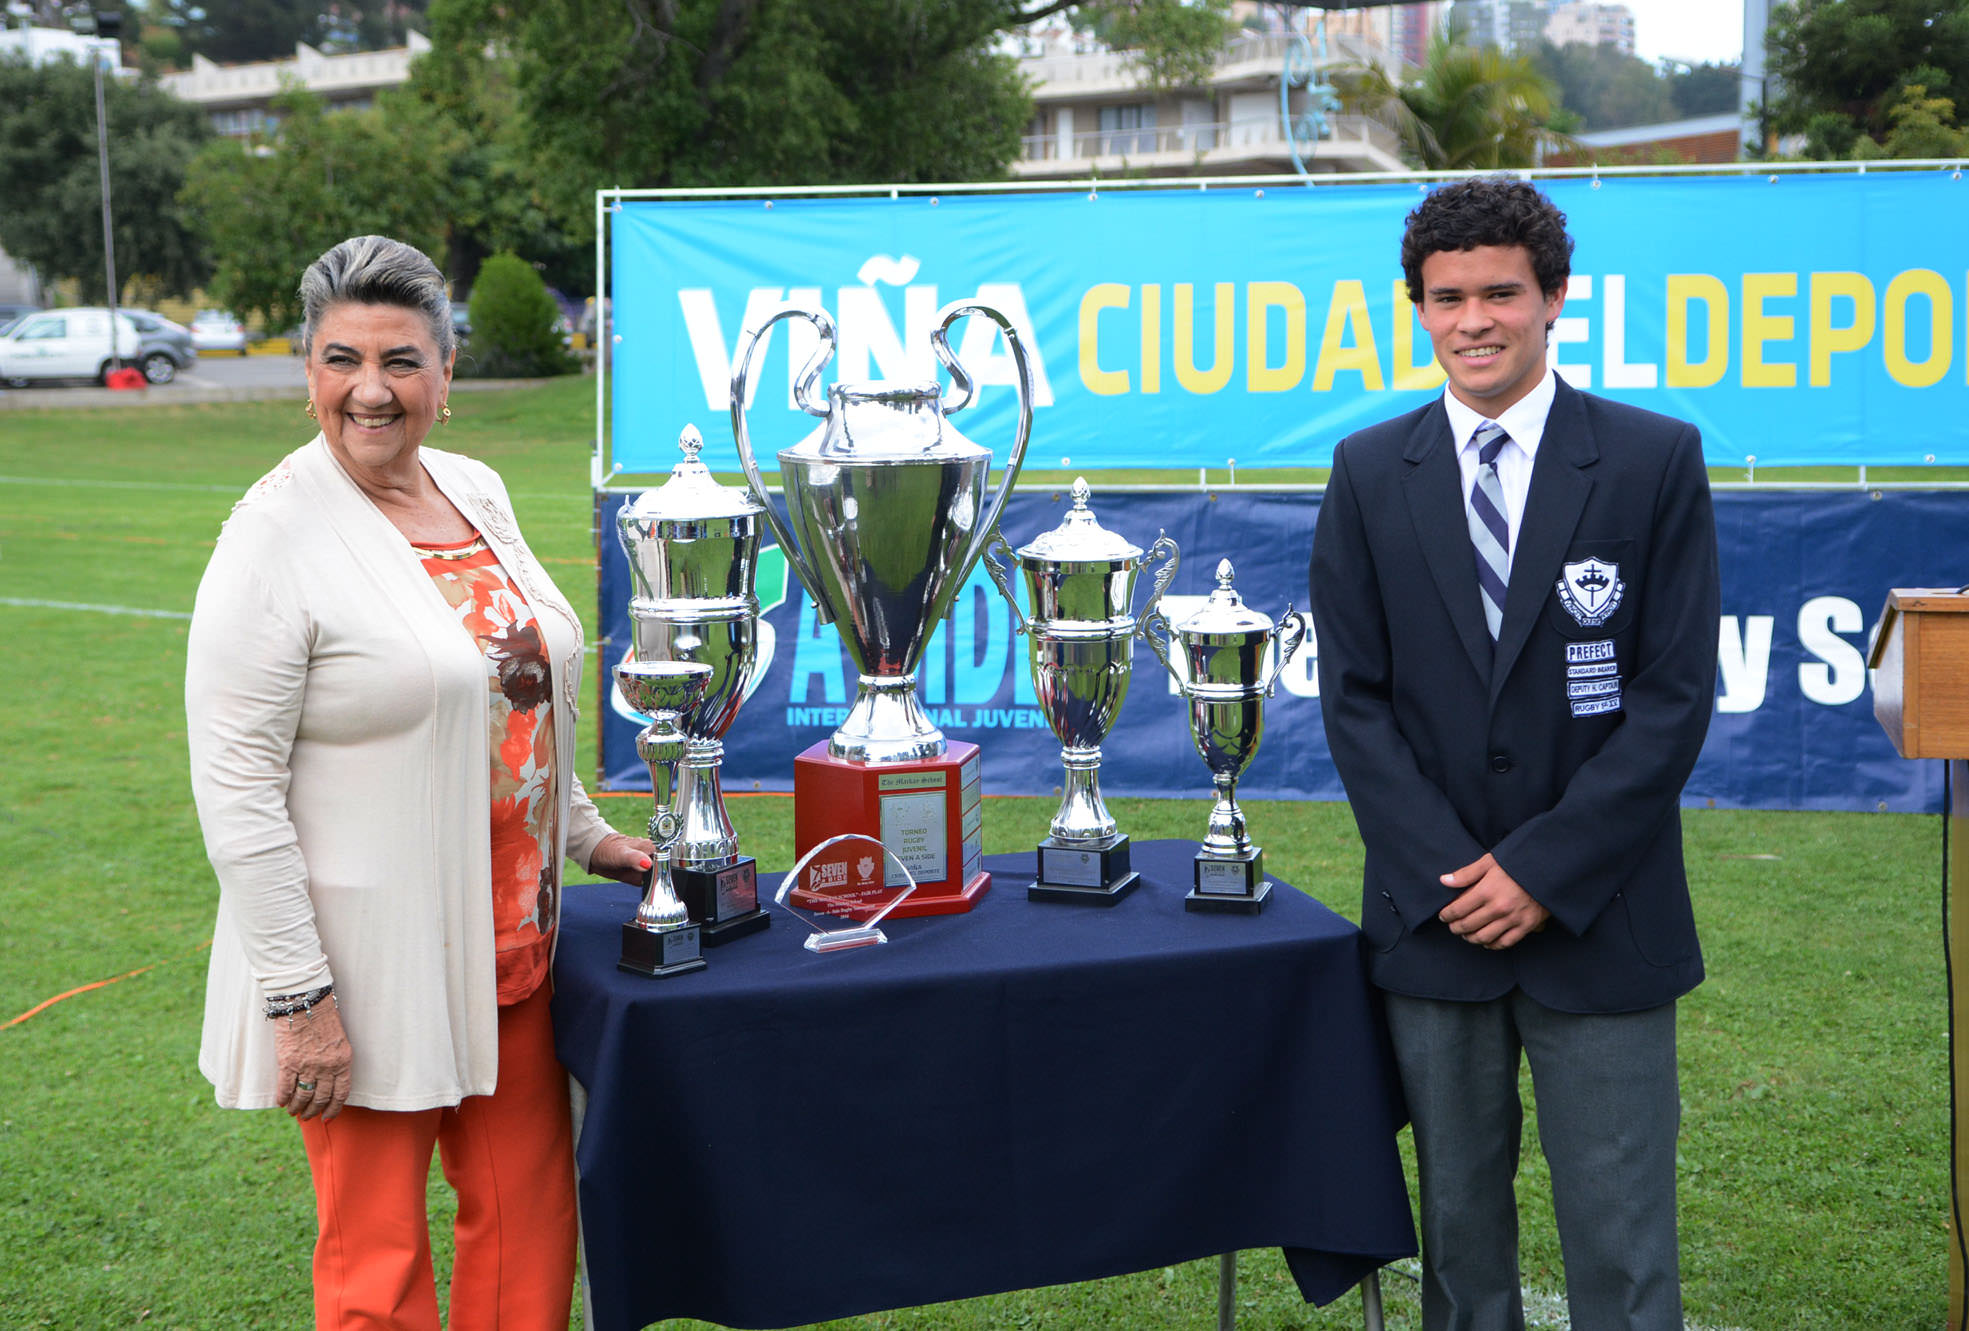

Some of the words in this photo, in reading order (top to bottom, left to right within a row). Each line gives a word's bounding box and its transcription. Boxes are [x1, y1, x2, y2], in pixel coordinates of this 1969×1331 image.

[677, 254, 1055, 411] VIÑA
[1547, 274, 1658, 389] EL
[1665, 268, 1969, 389] DEPO
[1569, 643, 1611, 660] PREFECT
[972, 709, 1050, 729] JUVEN
[901, 828, 928, 836] TORNEO
[821, 861, 848, 878] SEVEN
